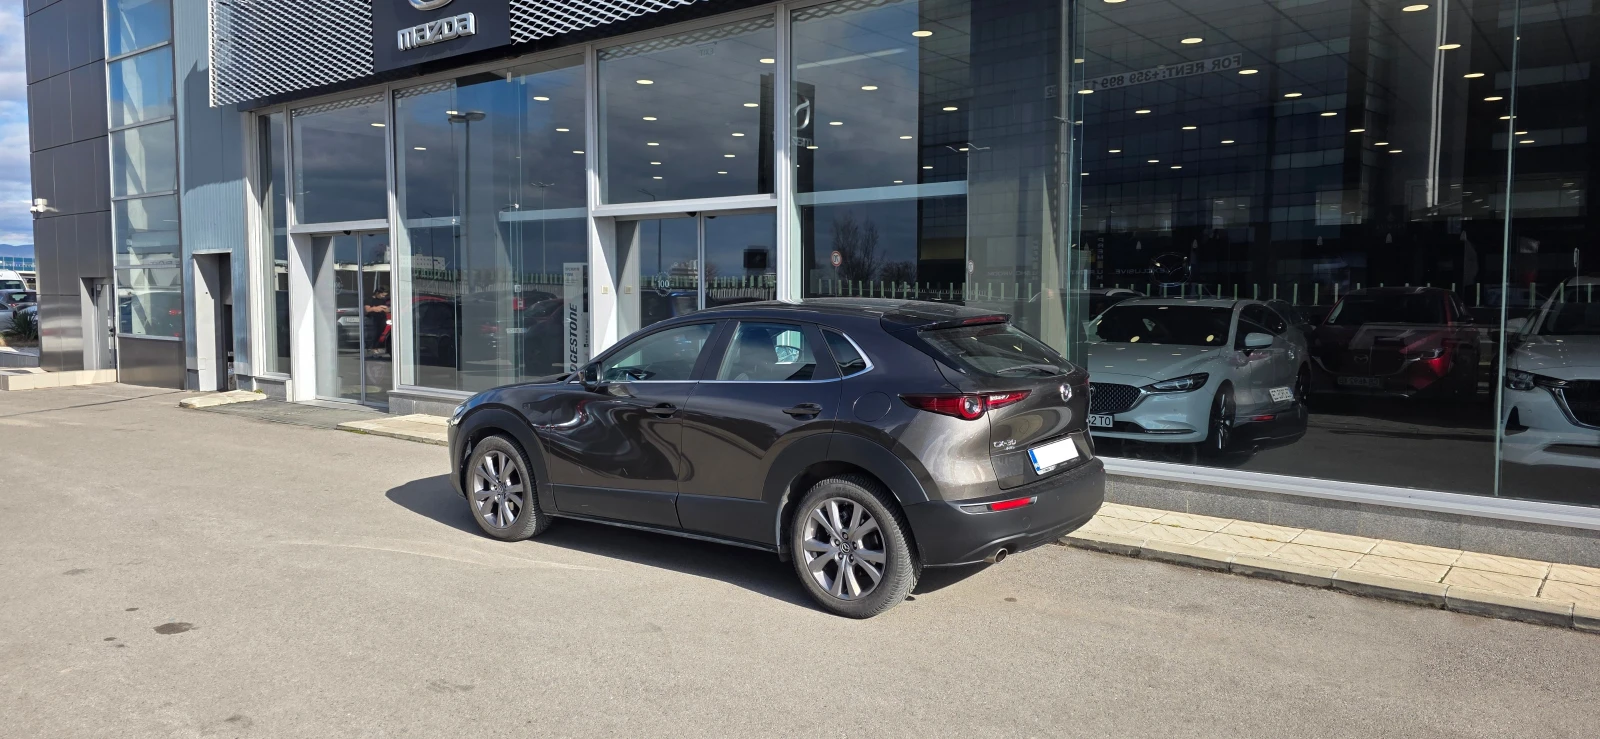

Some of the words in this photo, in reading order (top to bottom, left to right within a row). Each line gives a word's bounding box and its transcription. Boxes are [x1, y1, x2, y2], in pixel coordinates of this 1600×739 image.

[397, 12, 475, 51] mazda
[657, 279, 670, 289] 100
[1098, 415, 1111, 426] TO
